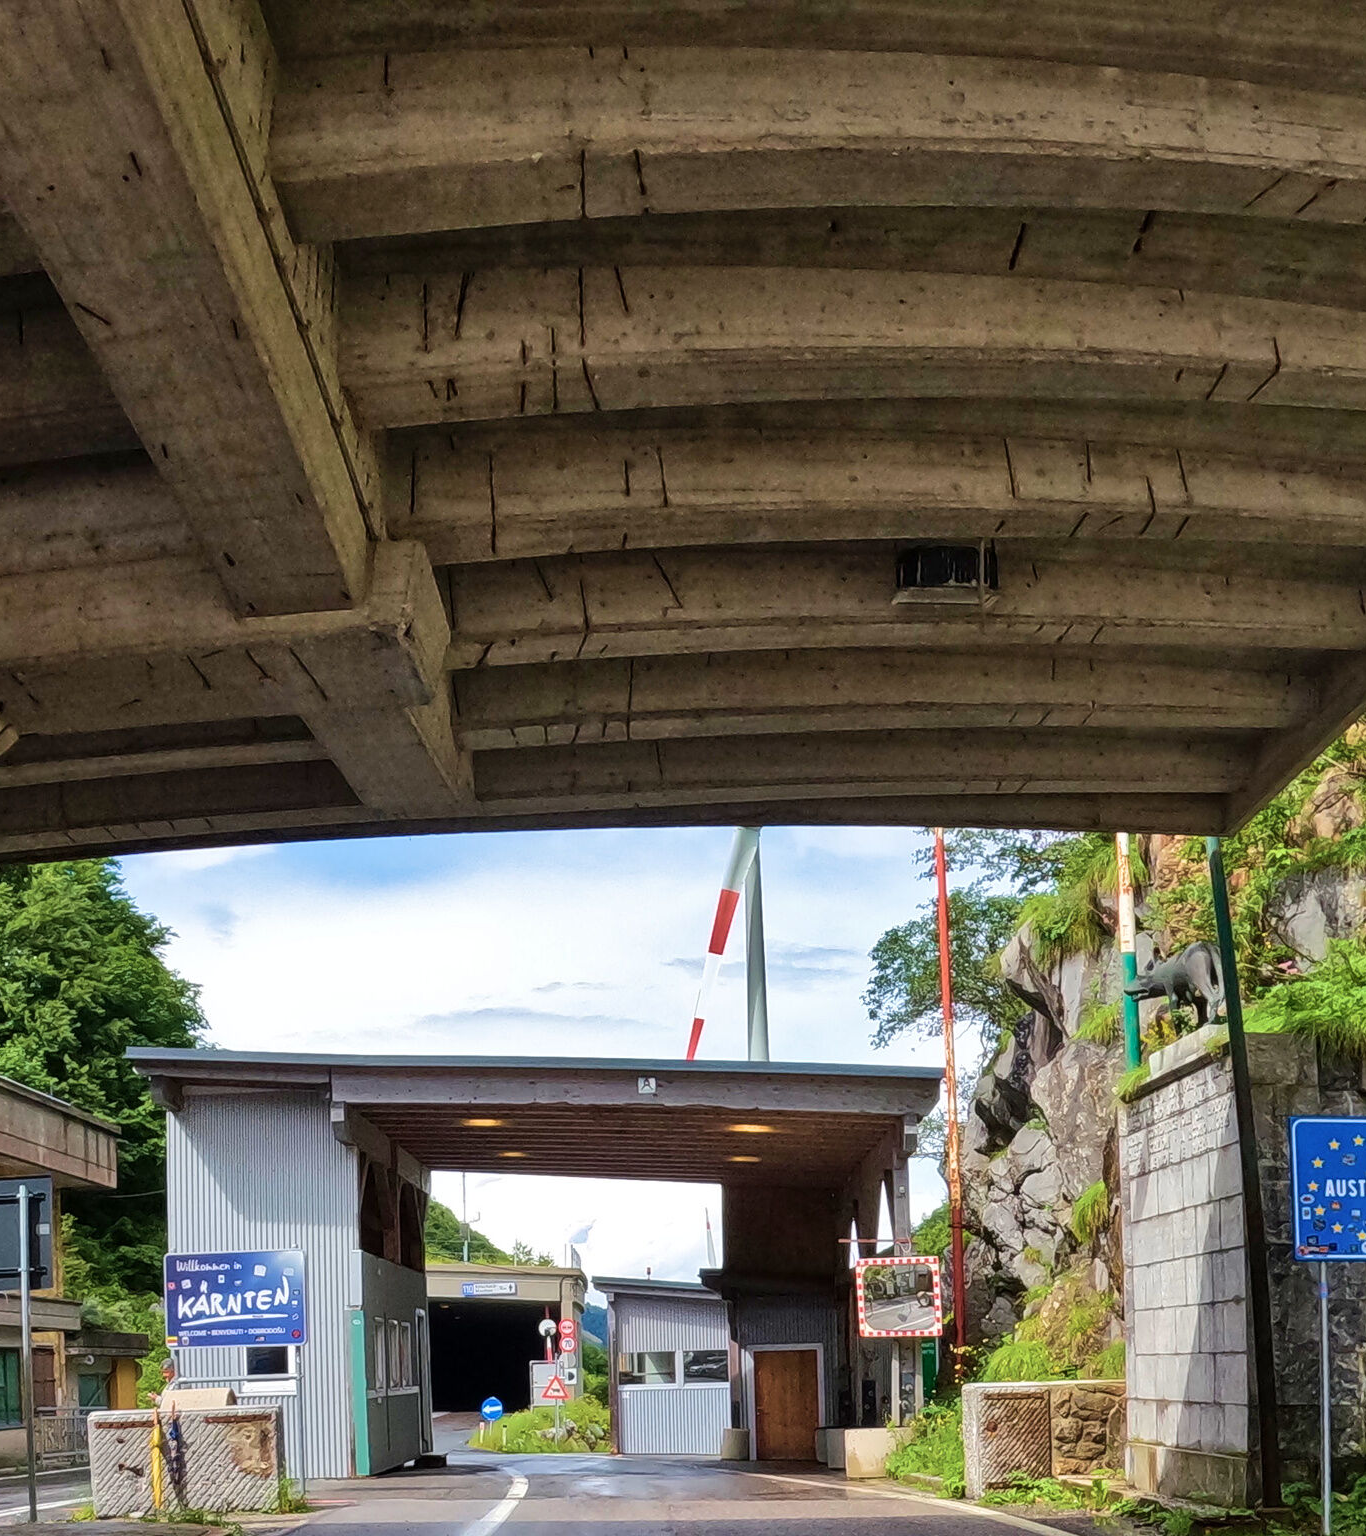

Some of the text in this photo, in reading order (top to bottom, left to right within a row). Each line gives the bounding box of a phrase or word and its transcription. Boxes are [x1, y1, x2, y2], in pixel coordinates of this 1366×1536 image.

[176, 1259, 243, 1272] Willkommen in
[463, 1285, 474, 1294] 110
[177, 1276, 290, 1319] KÄRNTEN
[178, 1329, 207, 1337] WELCOME
[564, 1339, 572, 1348] 70
